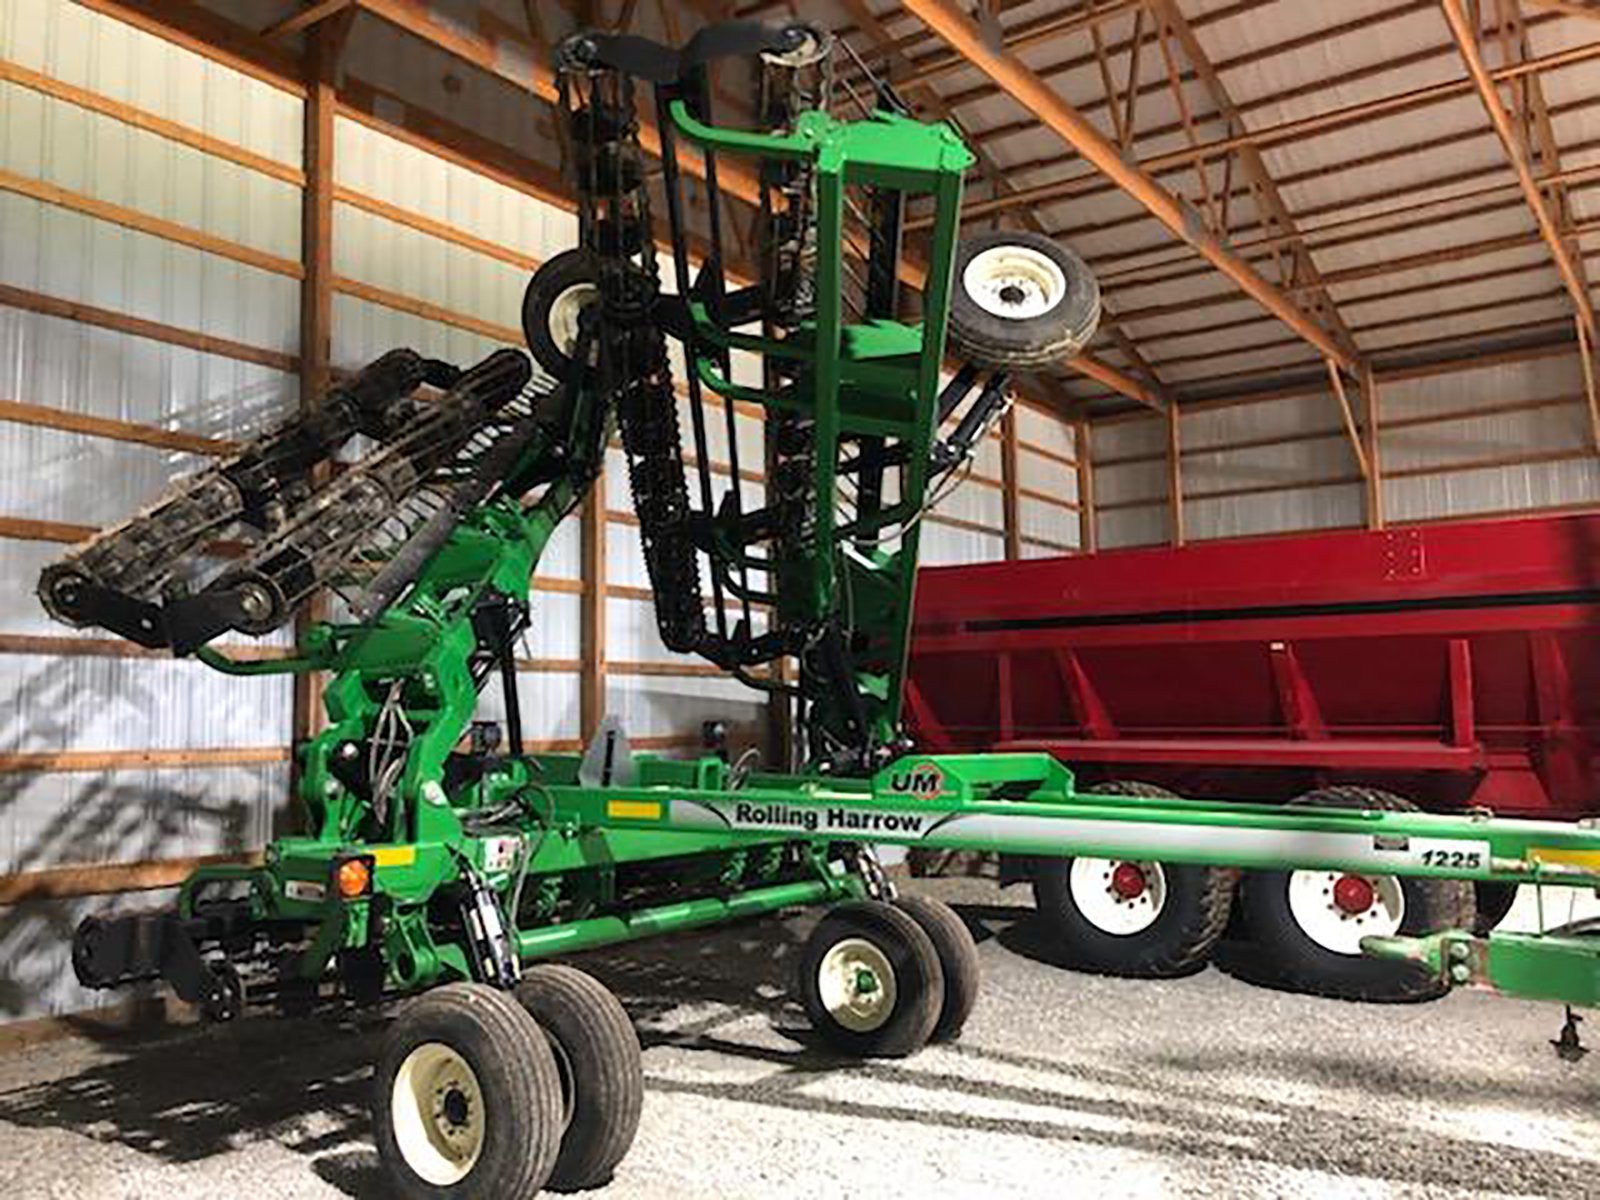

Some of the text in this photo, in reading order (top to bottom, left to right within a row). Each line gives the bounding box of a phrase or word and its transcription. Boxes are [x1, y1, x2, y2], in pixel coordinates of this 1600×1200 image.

[891, 774, 937, 792] UM
[736, 803, 922, 832] Rolling Harrow
[1421, 850, 1481, 869] 1225
